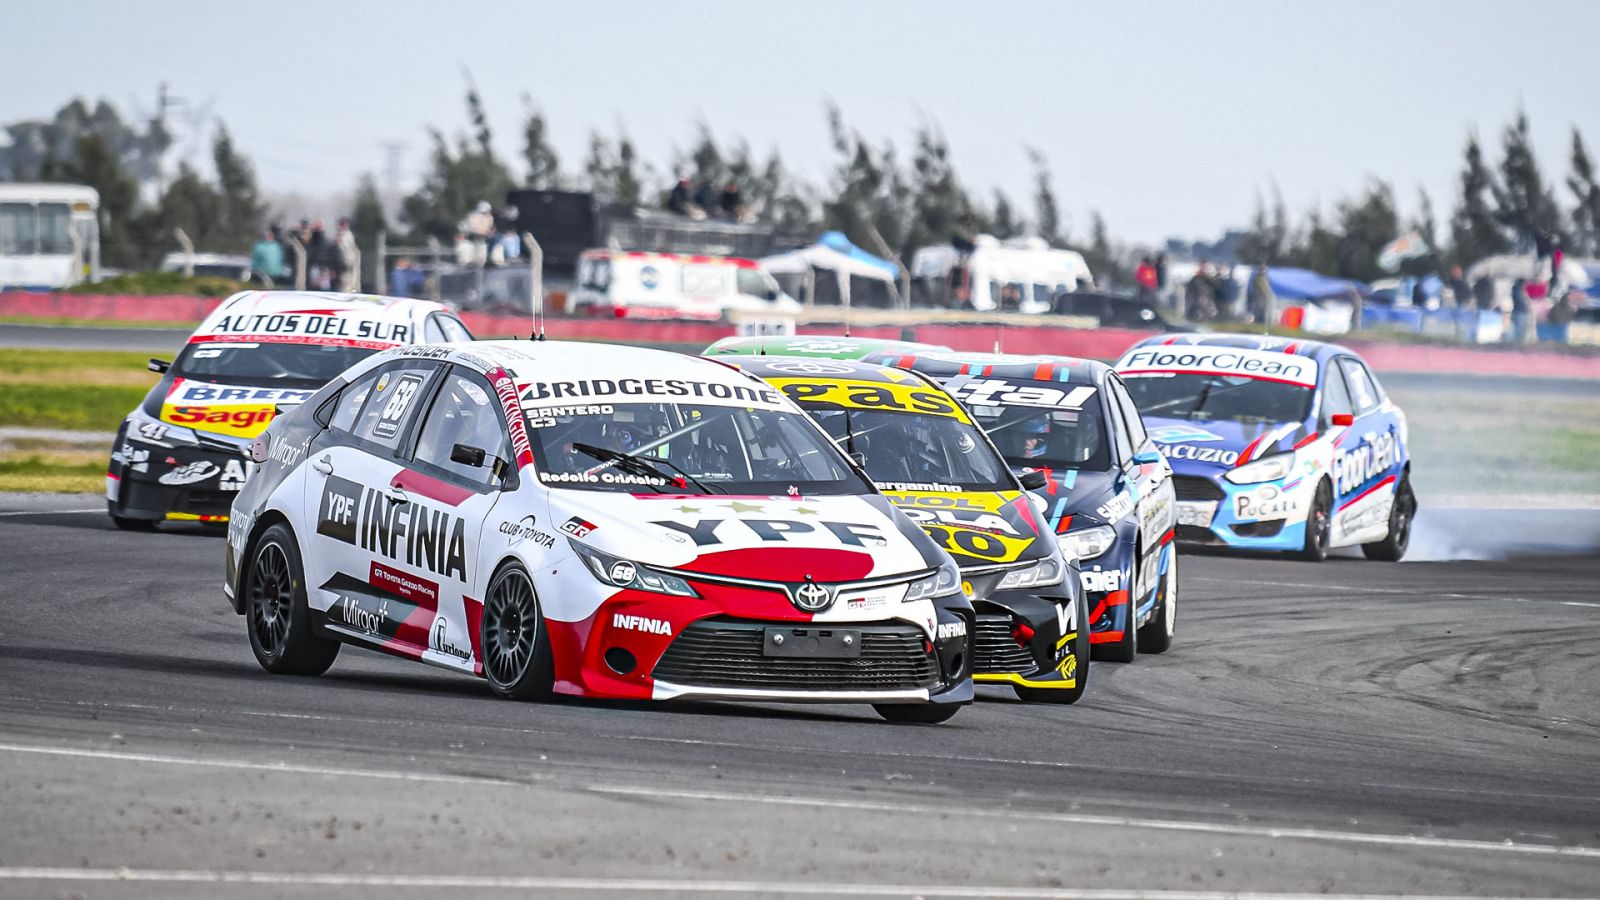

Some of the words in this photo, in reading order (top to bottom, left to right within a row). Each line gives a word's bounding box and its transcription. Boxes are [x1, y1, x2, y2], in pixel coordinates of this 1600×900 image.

[211, 315, 300, 333] AUTOS
[304, 316, 349, 336] DEL
[357, 320, 408, 342] SUR
[1126, 351, 1303, 378] FloorClean
[383, 381, 419, 421] 68
[518, 379, 782, 405] BRIDGESTONE
[781, 383, 955, 414] gas
[498, 382, 532, 458] PILKINGTON
[526, 404, 614, 419] SANTERO
[140, 422, 169, 440] 41
[269, 436, 301, 470] Mirgor
[539, 471, 599, 483] Rodolfo
[327, 491, 355, 526] YPF
[361, 487, 467, 583] INFINIA
[499, 520, 521, 536] CLUB
[524, 527, 556, 550] TOYOTA
[561, 519, 593, 539] GR
[646, 518, 888, 548] YPF
[611, 564, 635, 581] 68
[343, 596, 380, 635] Mirgor
[613, 613, 673, 636] INFINIA
[938, 621, 967, 638] INFINIA
